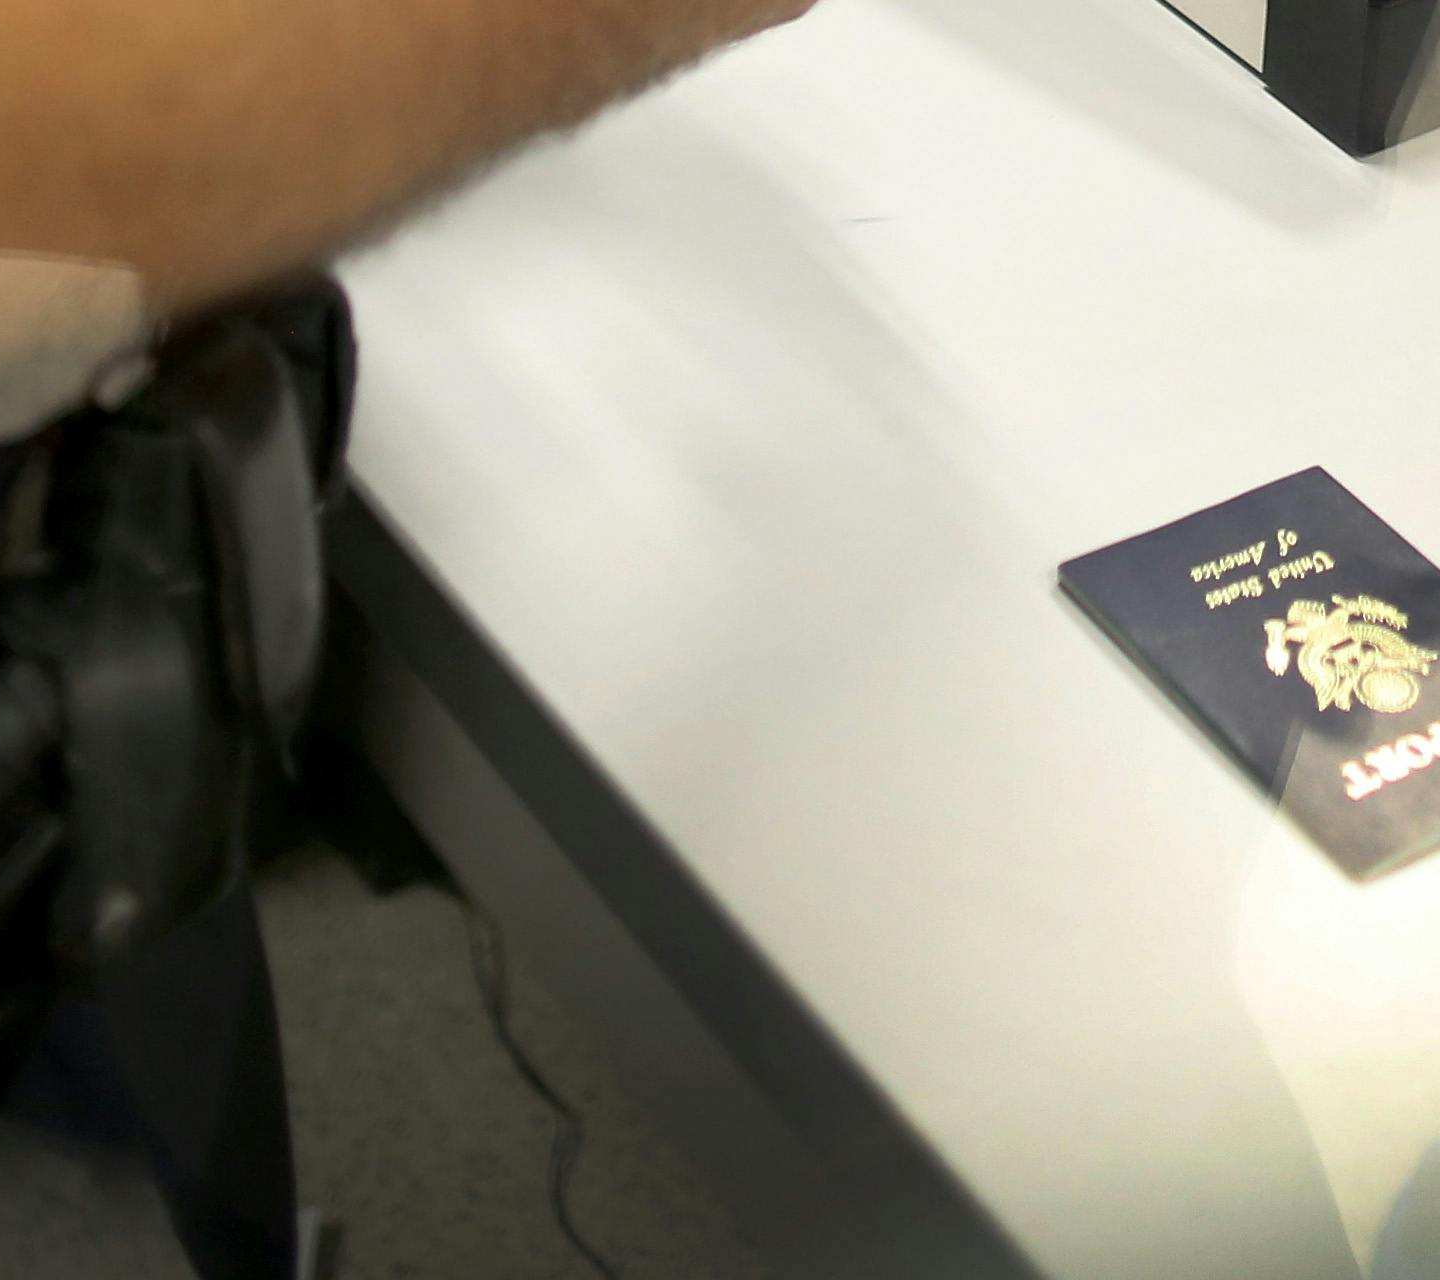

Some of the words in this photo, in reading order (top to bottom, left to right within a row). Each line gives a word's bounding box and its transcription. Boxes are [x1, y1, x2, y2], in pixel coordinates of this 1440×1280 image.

[1275, 527, 1298, 557] of
[1190, 541, 1266, 583] America
[1267, 550, 1336, 590] United
[1202, 574, 1262, 608] States
